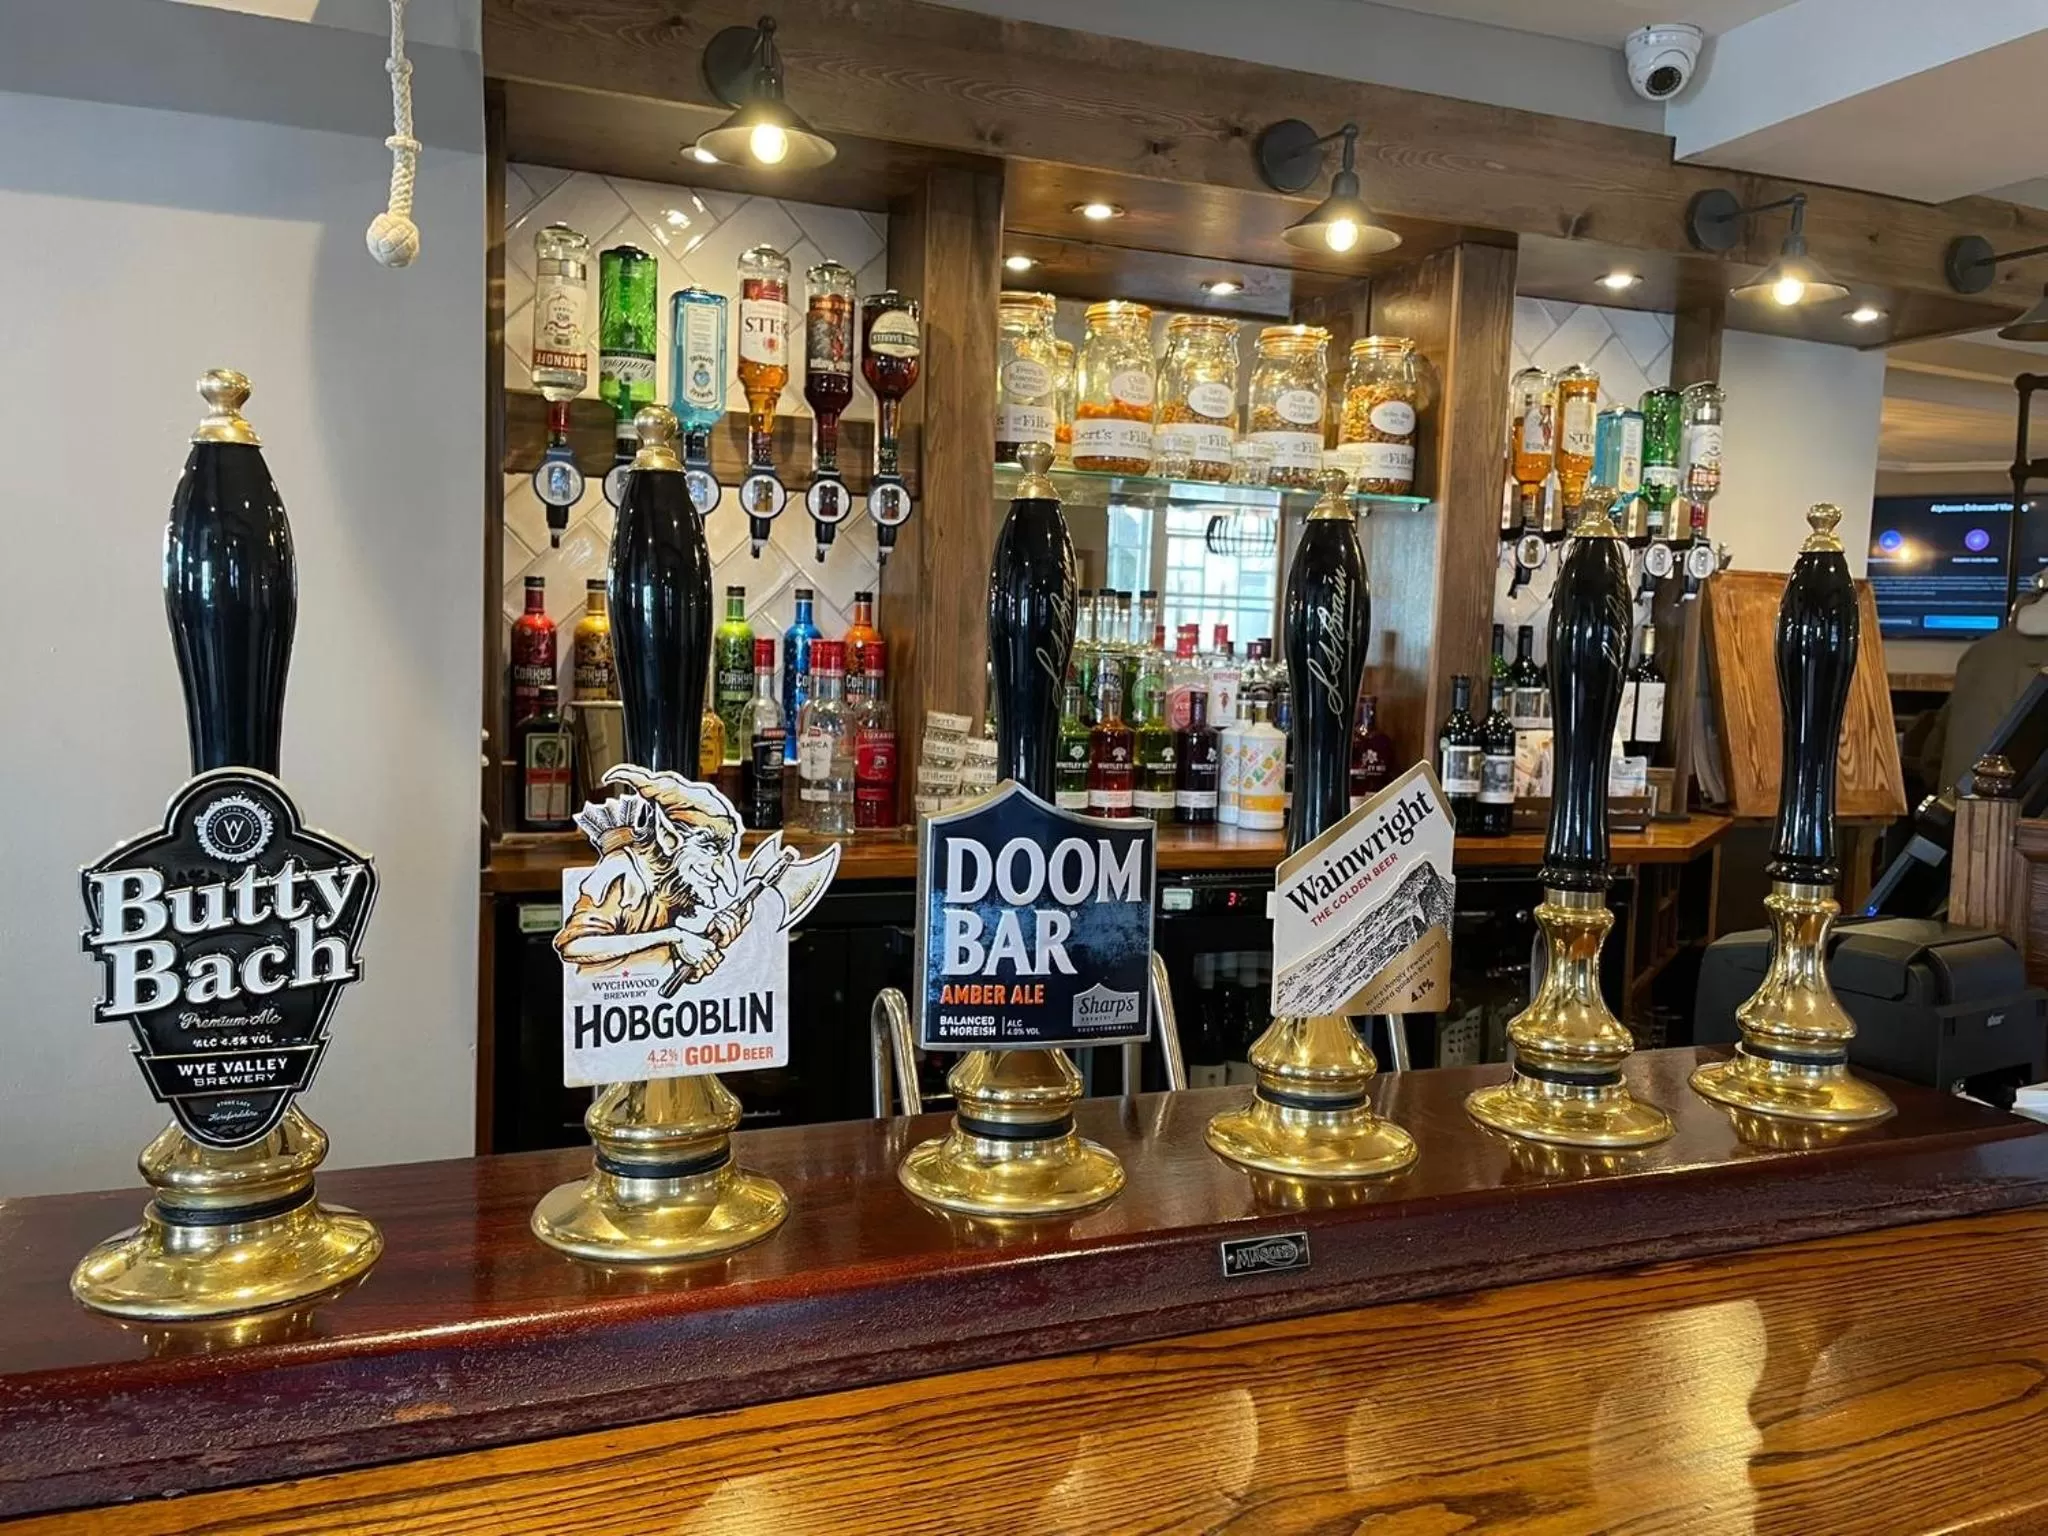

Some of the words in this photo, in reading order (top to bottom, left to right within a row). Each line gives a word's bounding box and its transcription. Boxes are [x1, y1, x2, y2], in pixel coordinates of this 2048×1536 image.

[1285, 790, 1435, 916] Wainwright
[943, 837, 1145, 906] DOOM
[1310, 906, 1333, 927] THE
[1333, 873, 1373, 910] GOLDEN
[1371, 852, 1400, 880] BEER
[88, 858, 366, 945] Butty
[941, 908, 1079, 977] BAR
[101, 914, 355, 1017] Bach
[592, 978, 660, 992] WYCHWOOD
[603, 990, 649, 1000] BREWERY
[939, 984, 1006, 1005] AMBER
[1010, 984, 1045, 1005] ALE
[1411, 978, 1435, 1004] 4.1%
[1078, 996, 1135, 1018] Sharp's
[179, 1011, 249, 1029] Premium
[573, 991, 774, 1049] HOBGOBLIN
[939, 1015, 995, 1026] BALANCED
[1007, 1019, 1023, 1028] ALC
[250, 1034, 274, 1045] VOL
[939, 1026, 948, 1036] &
[949, 1026, 997, 1037] MOREISH
[647, 1048, 679, 1064] 4.2%
[685, 1042, 742, 1066] GOLD
[743, 1046, 774, 1061] BEER
[178, 1062, 217, 1077] WYE
[222, 1057, 288, 1074] VALLEY
[193, 1073, 276, 1087] BREWERY
